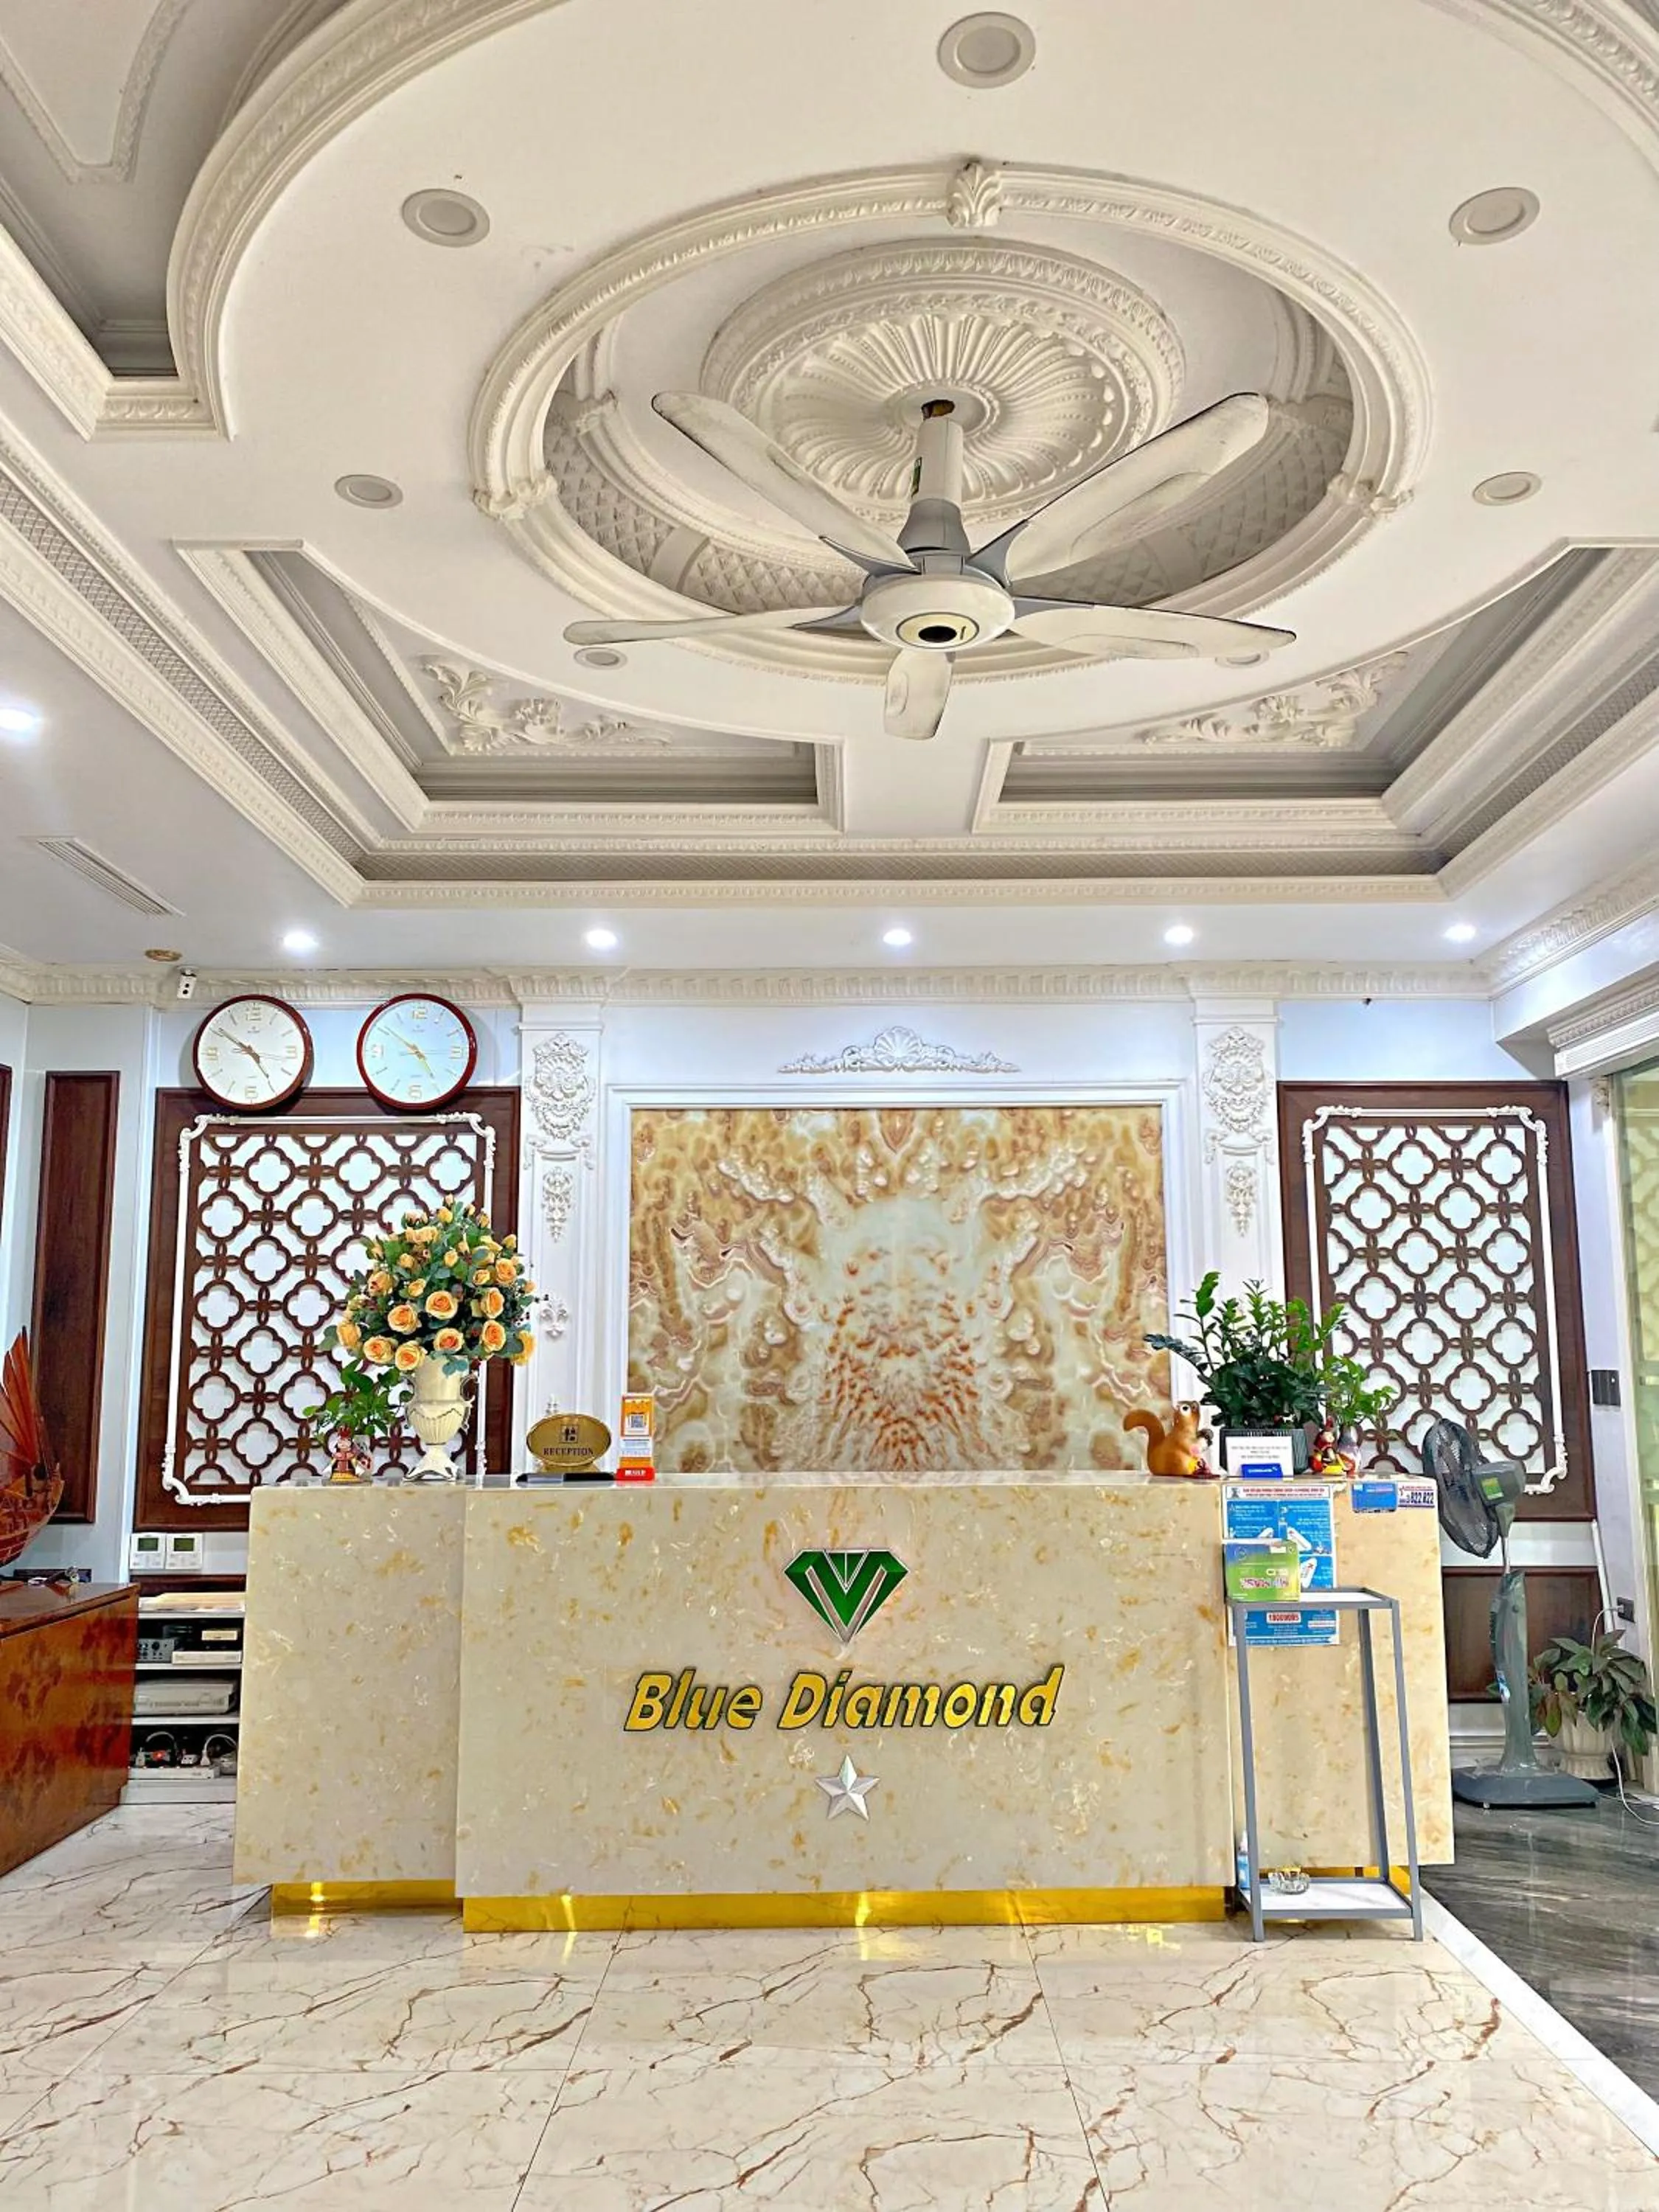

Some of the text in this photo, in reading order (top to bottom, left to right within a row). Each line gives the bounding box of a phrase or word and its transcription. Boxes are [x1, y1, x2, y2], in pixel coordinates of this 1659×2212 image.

[411, 1006, 428, 1020] 12
[285, 1045, 297, 1059] 3
[371, 1043, 384, 1058] 9
[449, 1045, 463, 1060] 3
[245, 1085, 259, 1099] 6
[408, 1084, 422, 1099] 6
[543, 1447, 594, 1456] RECEPTION
[624, 1664, 1065, 1731] Blue Diamond
